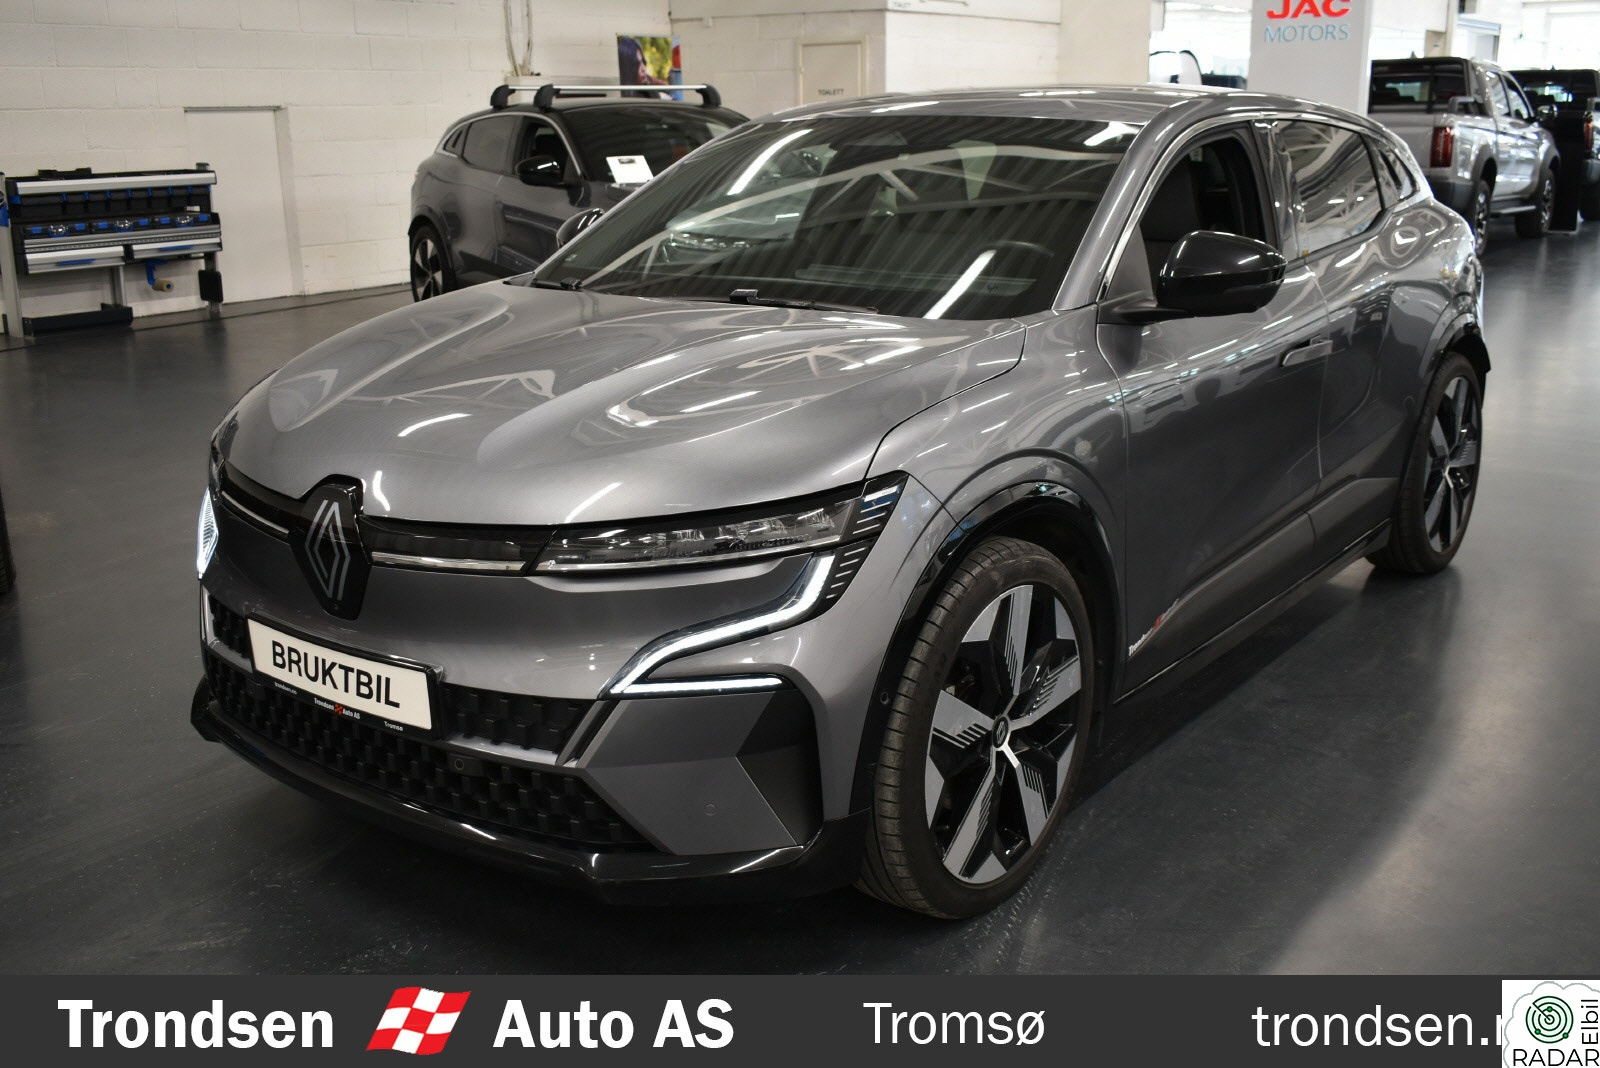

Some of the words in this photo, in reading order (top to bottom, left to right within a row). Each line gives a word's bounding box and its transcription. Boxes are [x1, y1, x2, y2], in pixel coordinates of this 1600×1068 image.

[1266, 0, 1352, 19] JAC
[1264, 24, 1351, 43] MOTORS
[272, 640, 400, 708] BRUKTBIL
